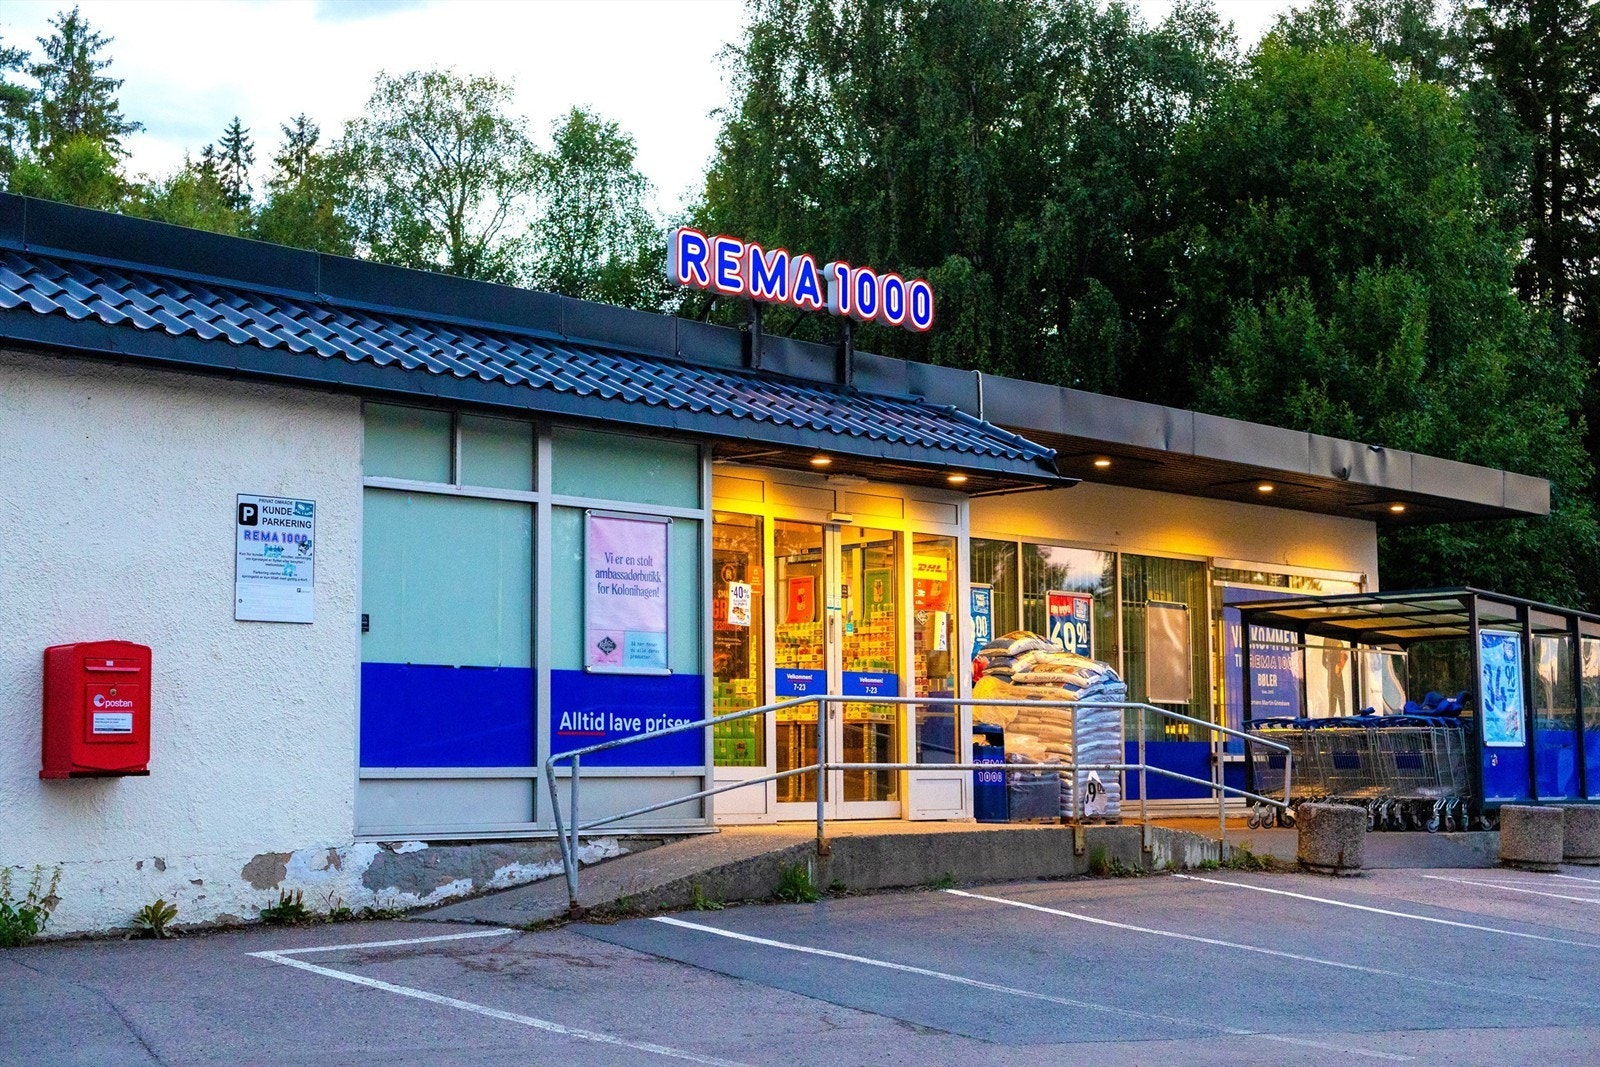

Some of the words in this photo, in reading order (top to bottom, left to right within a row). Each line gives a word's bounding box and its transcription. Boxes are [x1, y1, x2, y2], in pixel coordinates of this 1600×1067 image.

[675, 226, 824, 312] REMA
[833, 259, 935, 332] 1000
[243, 506, 254, 522] P
[262, 517, 312, 529] PARKERING
[243, 530, 279, 543] REMA
[282, 532, 308, 545] 1000
[604, 551, 614, 564] Vi
[615, 555, 624, 565] er
[625, 556, 635, 566] en
[636, 555, 653, 567] stolt
[917, 563, 942, 573] DHL
[595, 568, 662, 583] ambassadørbutikk
[597, 582, 609, 595] for
[611, 583, 660, 599] Kolonihagen!
[786, 673, 813, 681] Velkommen!
[859, 676, 884, 684] Velkommen!
[1257, 673, 1278, 687] BØLER
[793, 683, 806, 691] 7-23
[865, 686, 878, 694] 7-23
[105, 699, 133, 709] posten
[559, 711, 605, 731] Alltid
[609, 712, 642, 731] lave
